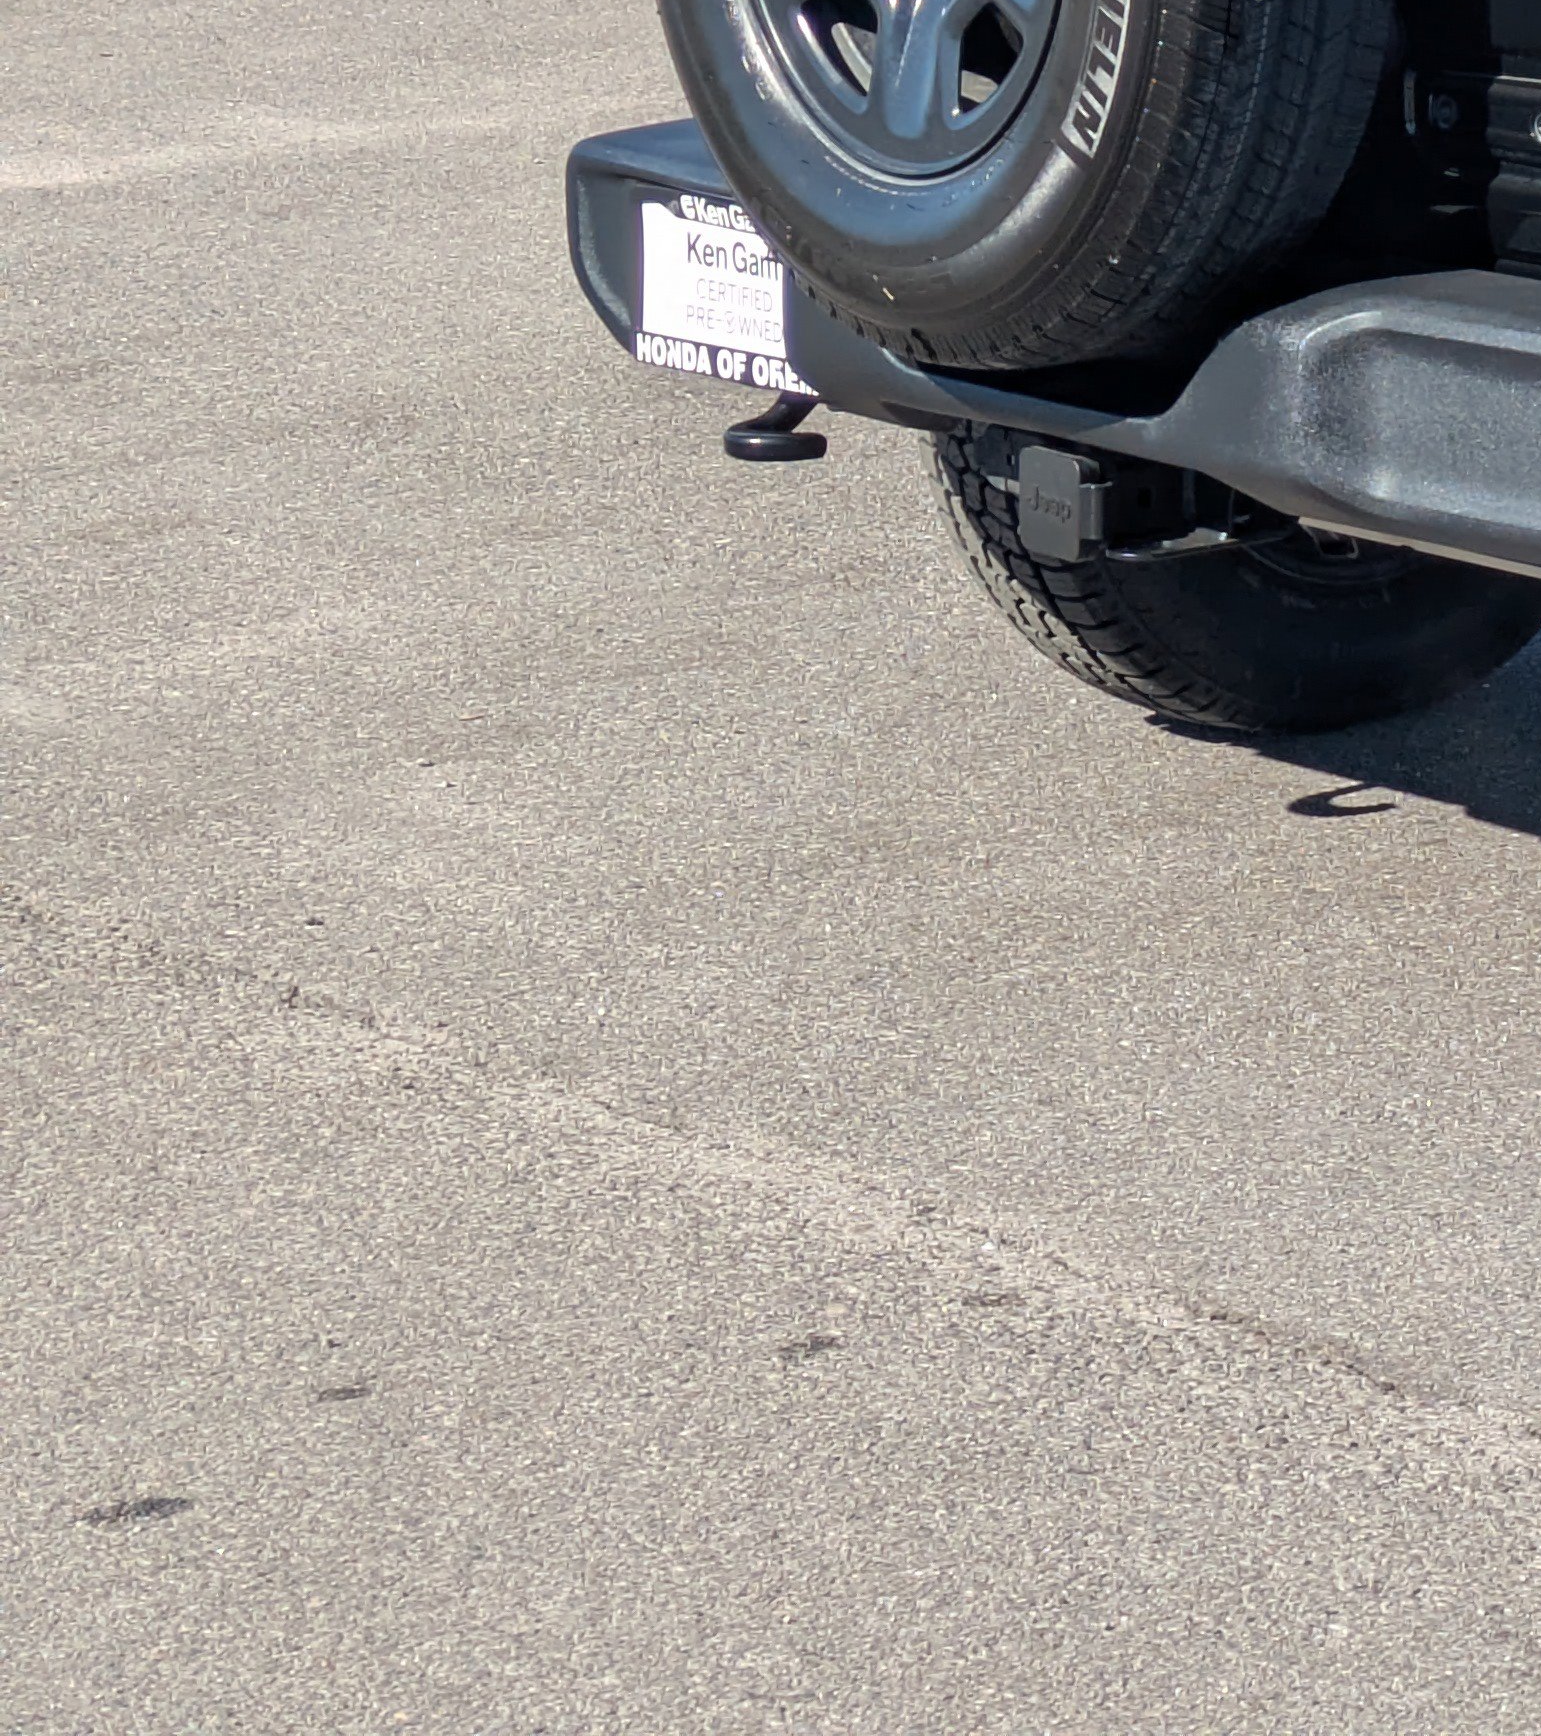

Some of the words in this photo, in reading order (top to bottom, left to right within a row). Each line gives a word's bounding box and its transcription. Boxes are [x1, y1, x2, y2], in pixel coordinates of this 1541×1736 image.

[687, 231, 728, 270] Ken
[696, 277, 773, 313] CERTIFIED
[686, 304, 783, 343] PRE-OWNED
[636, 332, 712, 375] HONDA
[716, 349, 747, 381] OF
